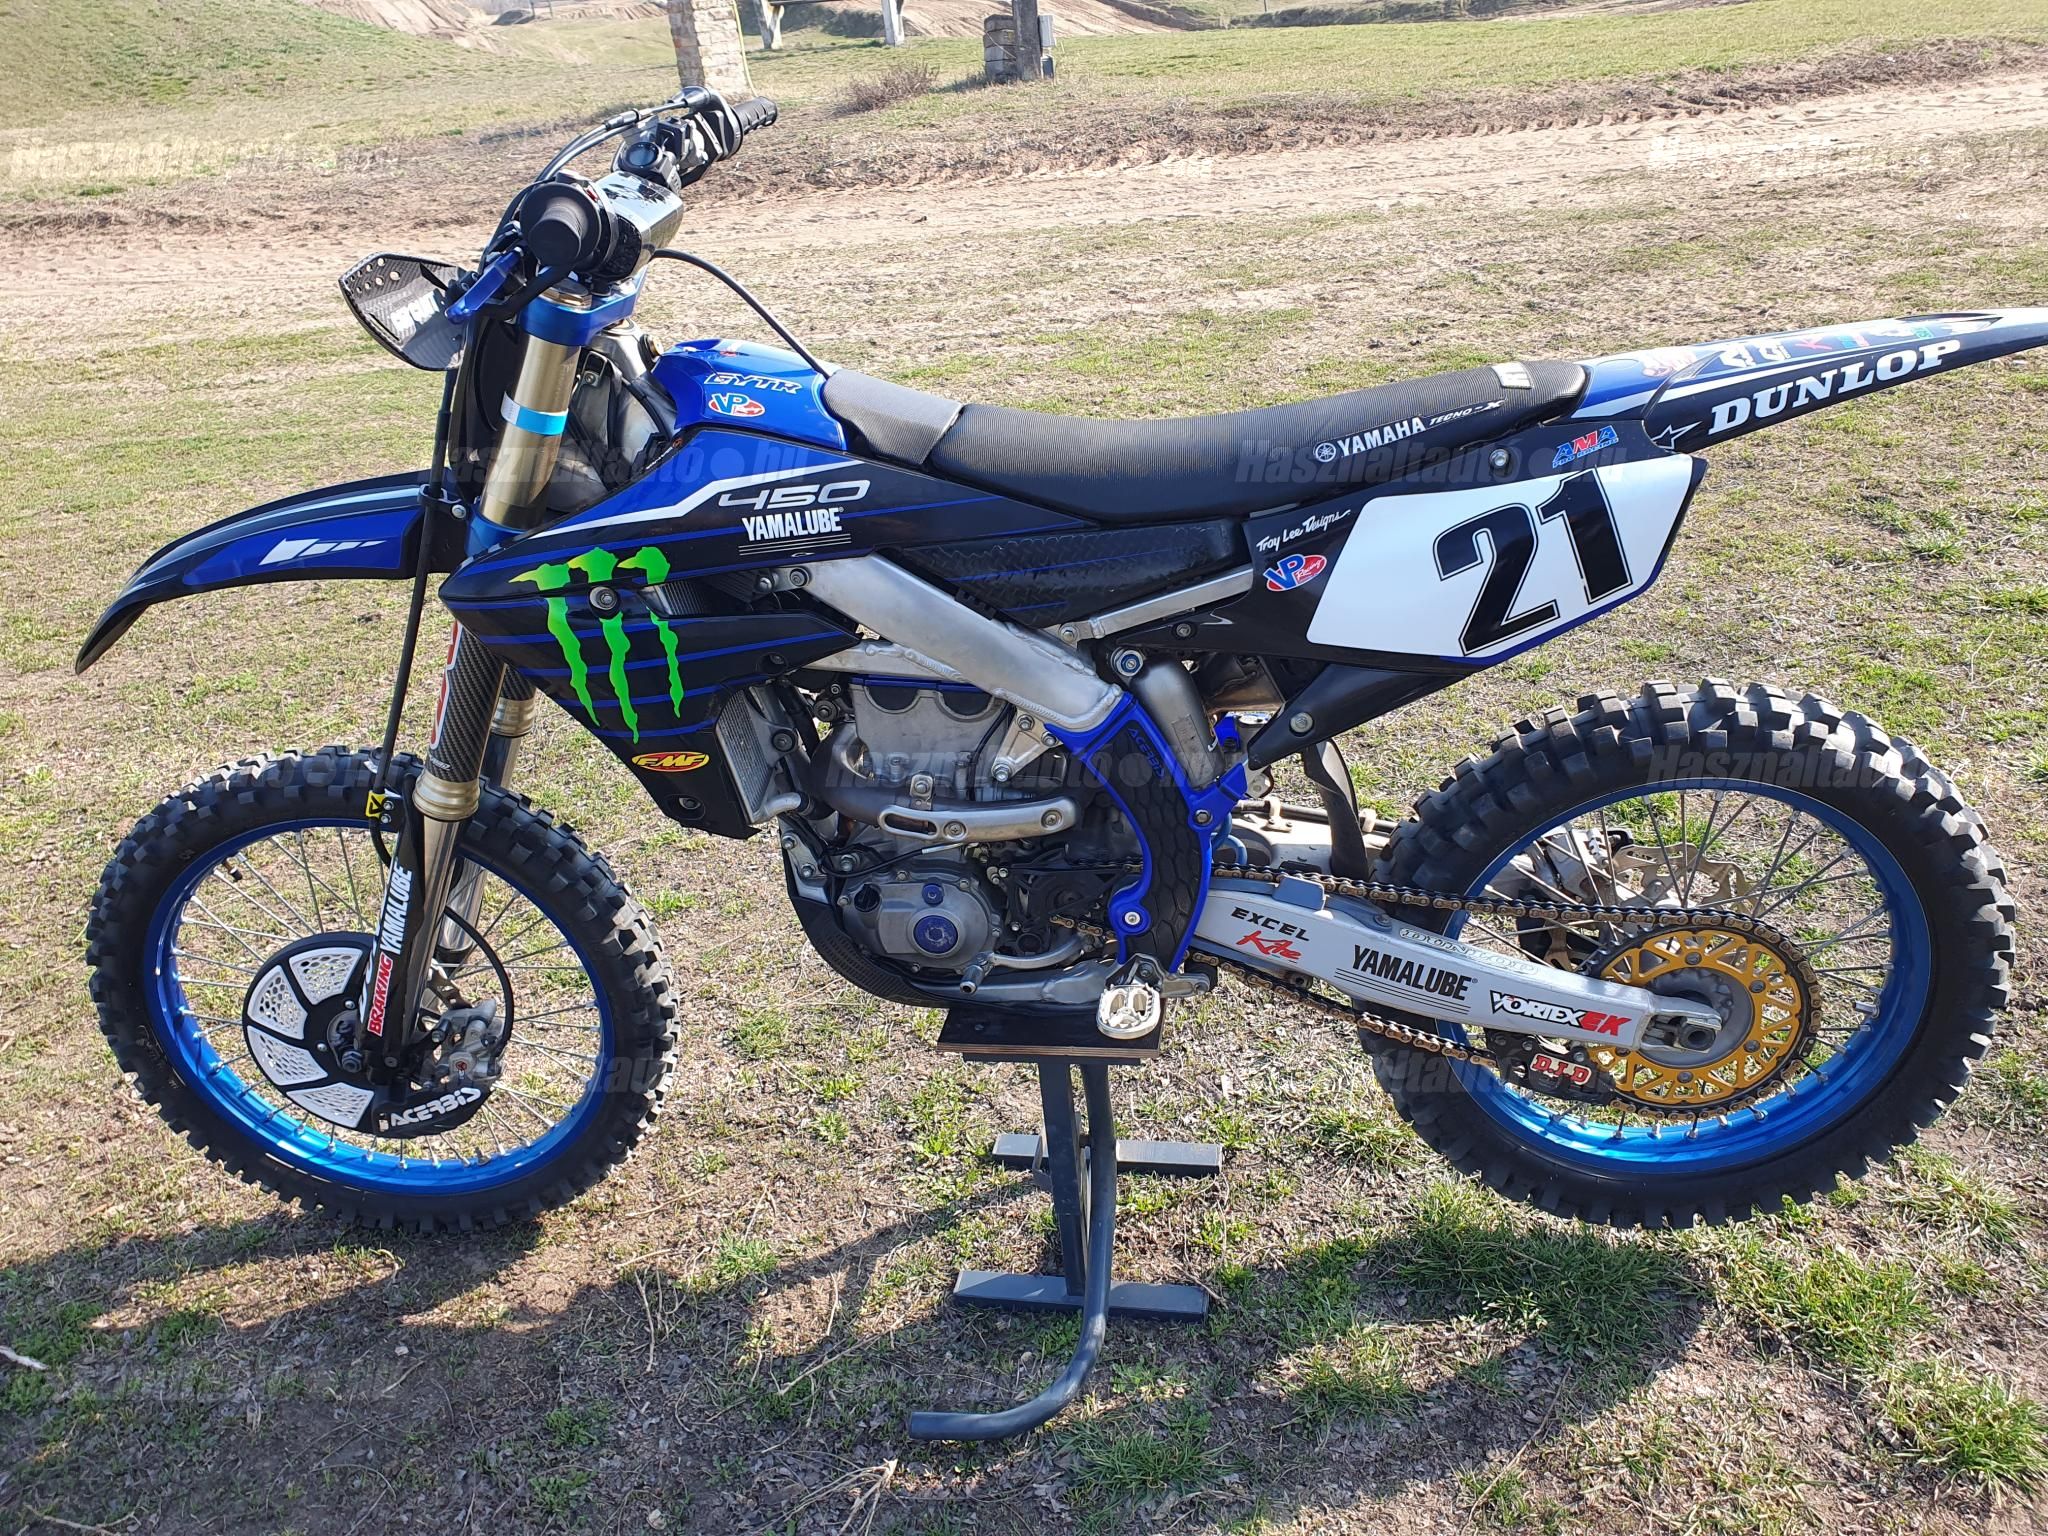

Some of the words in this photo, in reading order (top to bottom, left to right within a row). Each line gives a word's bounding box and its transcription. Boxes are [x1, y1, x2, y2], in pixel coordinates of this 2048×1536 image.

[704, 372, 804, 394] GYTR
[1706, 339, 1961, 436] DUNLOP
[711, 392, 750, 416] VP
[1336, 416, 1427, 458] YAMAHA
[1553, 424, 1618, 463] AMA
[718, 479, 871, 510] 450
[741, 507, 844, 542] YAMALUBE
[1256, 535, 1281, 552] Troy
[1282, 528, 1304, 543] Lee
[1302, 509, 1351, 533] Designs
[1263, 553, 1307, 591] VP
[1432, 466, 1633, 656] 21
[636, 753, 706, 767] FMF
[380, 858, 413, 955] YAMALUBE
[1231, 906, 1310, 942] EXCEL
[1351, 943, 1474, 1001] YAMALUBE
[367, 952, 393, 1037] BRAKING
[1532, 1055, 1590, 1084] D.I.D
[390, 1087, 482, 1128] ACERBIS
